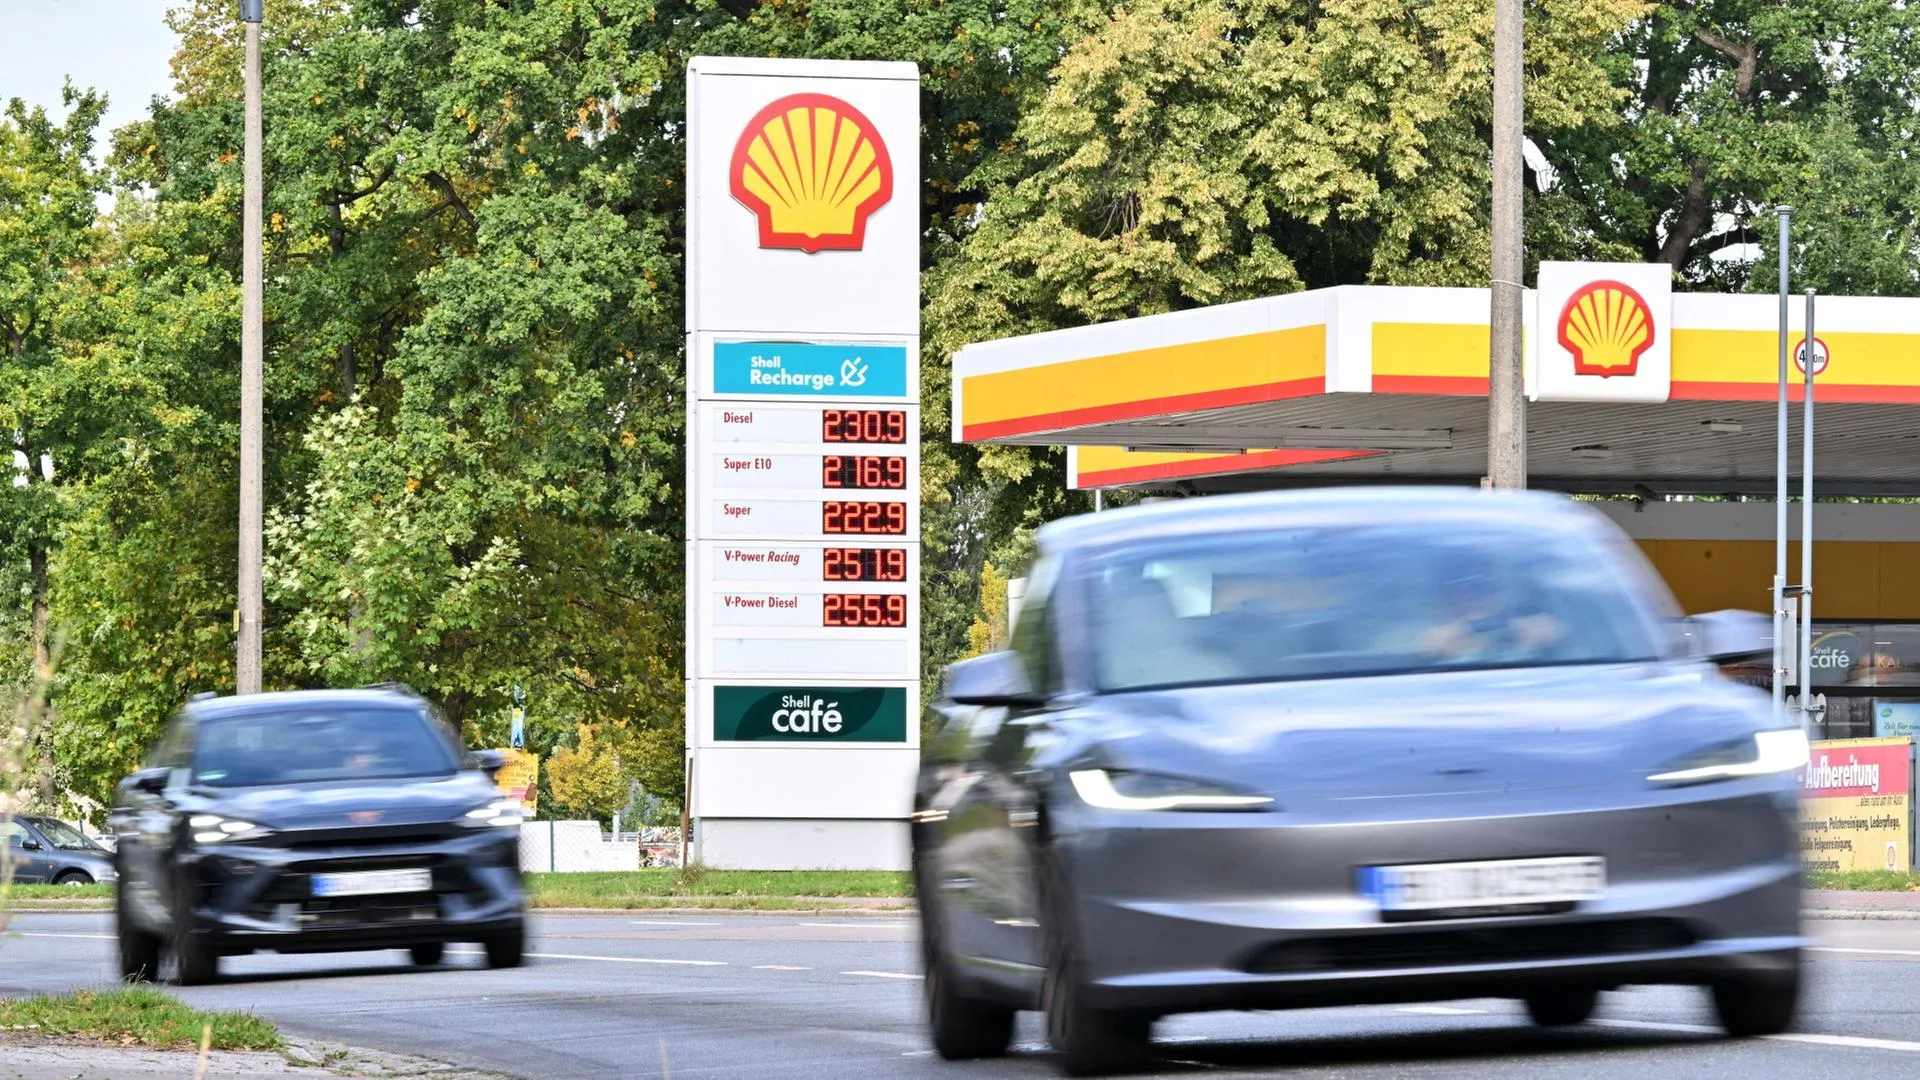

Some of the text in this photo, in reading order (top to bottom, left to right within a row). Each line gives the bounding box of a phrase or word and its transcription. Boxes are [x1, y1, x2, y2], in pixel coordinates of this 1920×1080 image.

[750, 356, 781, 368] Shell
[750, 369, 834, 390] Recharge
[723, 412, 753, 424] Diesel
[824, 410, 904, 441] 230.9
[723, 458, 772, 472] Super E10
[824, 456, 904, 487] 216.9
[723, 504, 752, 517] Super
[824, 502, 904, 533] 222.9
[724, 550, 800, 565] V-Power Racing
[824, 549, 904, 580] 251.9
[724, 595, 798, 608] V-Power Diesel
[824, 594, 904, 625] 255.9
[1810, 649, 1850, 668] café
[1813, 646, 1831, 655] Shell
[782, 695, 810, 708] Shell
[771, 699, 843, 733] café
[1804, 754, 1880, 793] Aufbereitung
[1829, 816, 1869, 831] Polsterreinigung,
[1870, 813, 1901, 831] Lederpflege,
